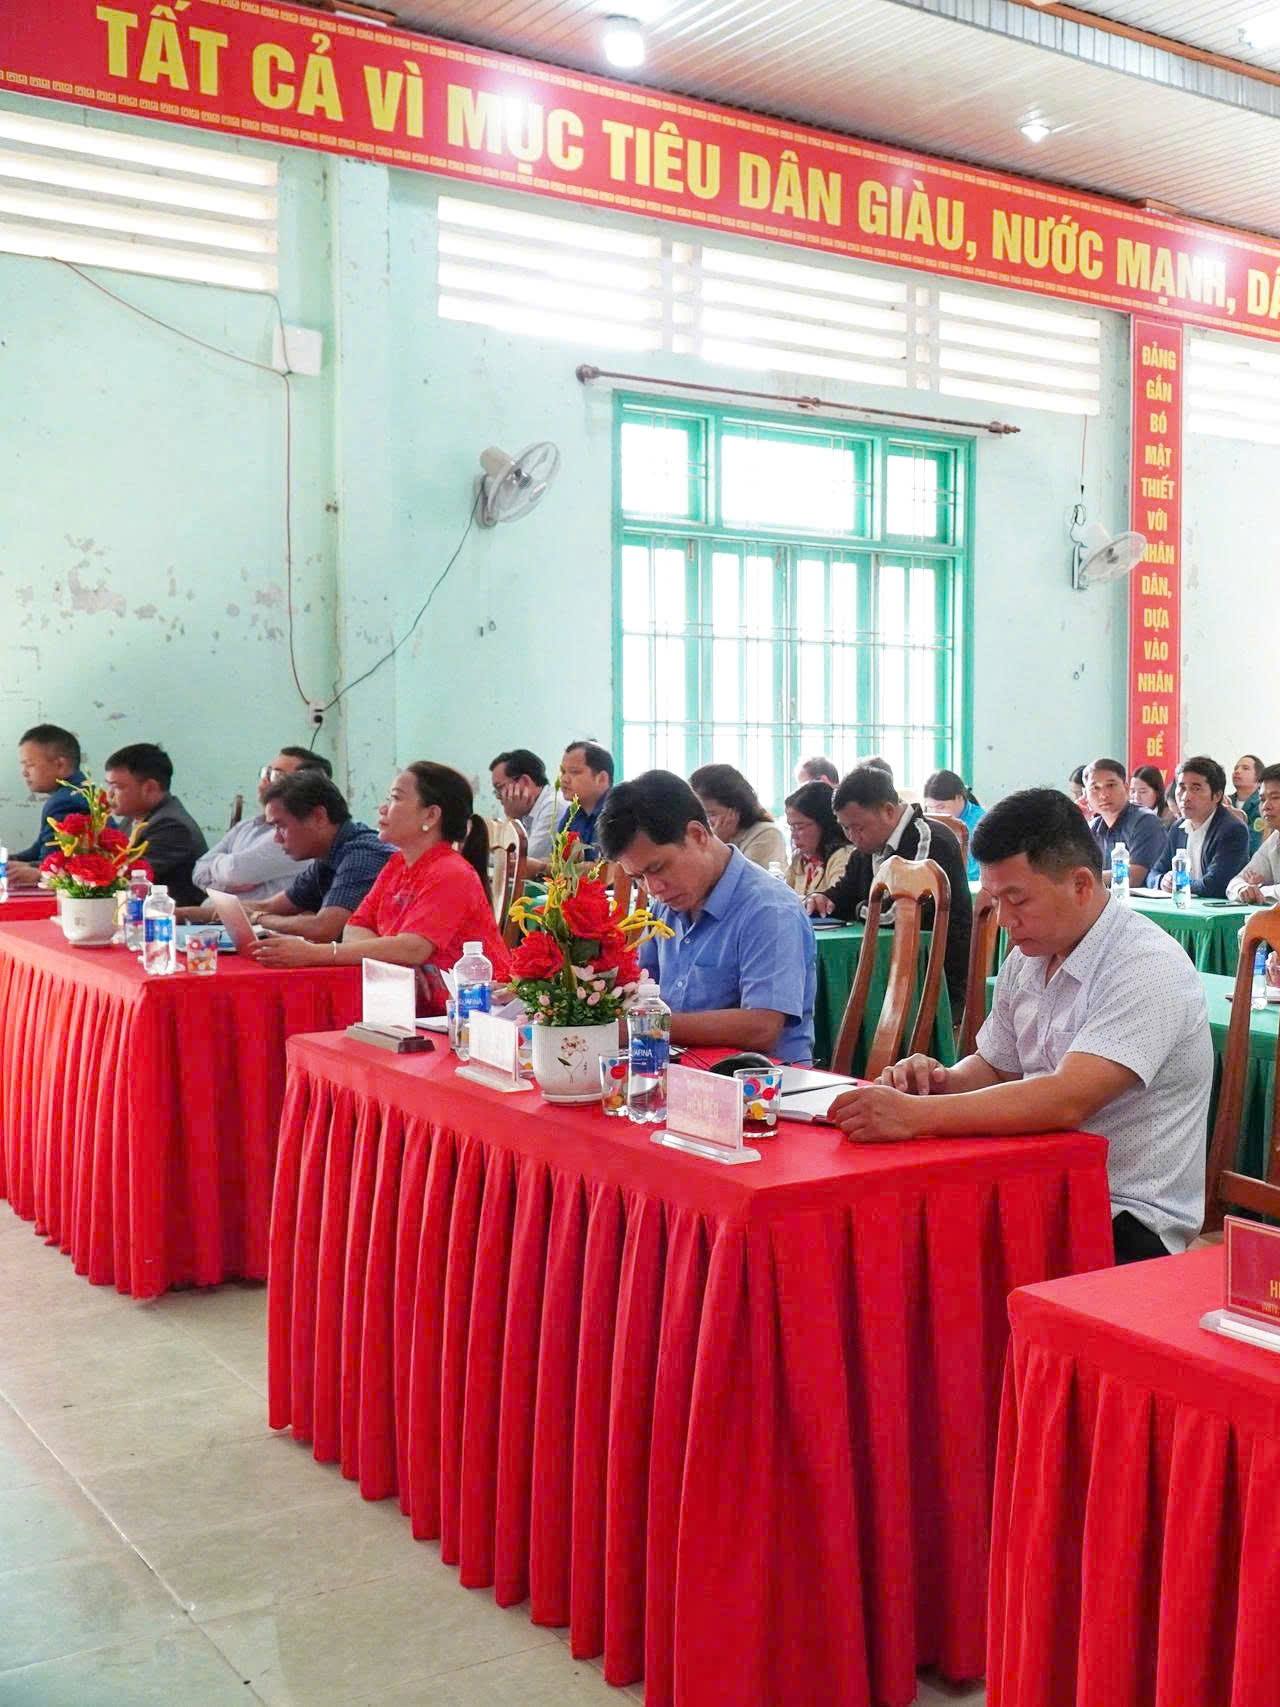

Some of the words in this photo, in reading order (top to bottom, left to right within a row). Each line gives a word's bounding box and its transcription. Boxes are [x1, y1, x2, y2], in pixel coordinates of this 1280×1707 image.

[96, 0, 228, 97] TẤT
[252, 32, 344, 122] CẢ
[363, 60, 424, 138] VÌ
[448, 84, 584, 175] MỤC
[602, 119, 720, 200] TIÊU
[739, 150, 842, 227] DÂN
[858, 179, 976, 261] GIÀU,
[993, 208, 1103, 281] NƯỚC
[1117, 238, 1236, 316] MẠNH,
[1142, 341, 1176, 371] ĐẢNG
[1146, 374, 1172, 402] GẮN
[1145, 443, 1171, 470] MẬT
[1141, 474, 1175, 499] THIẾT
[1147, 508, 1168, 531] VỚI
[1141, 572, 1172, 599] DÂN,
[1144, 607, 1169, 632] DỰA
[1144, 637, 1168, 661] VÀO
[1138, 670, 1174, 693] NHÂN
[1142, 702, 1169, 725] DÂN
